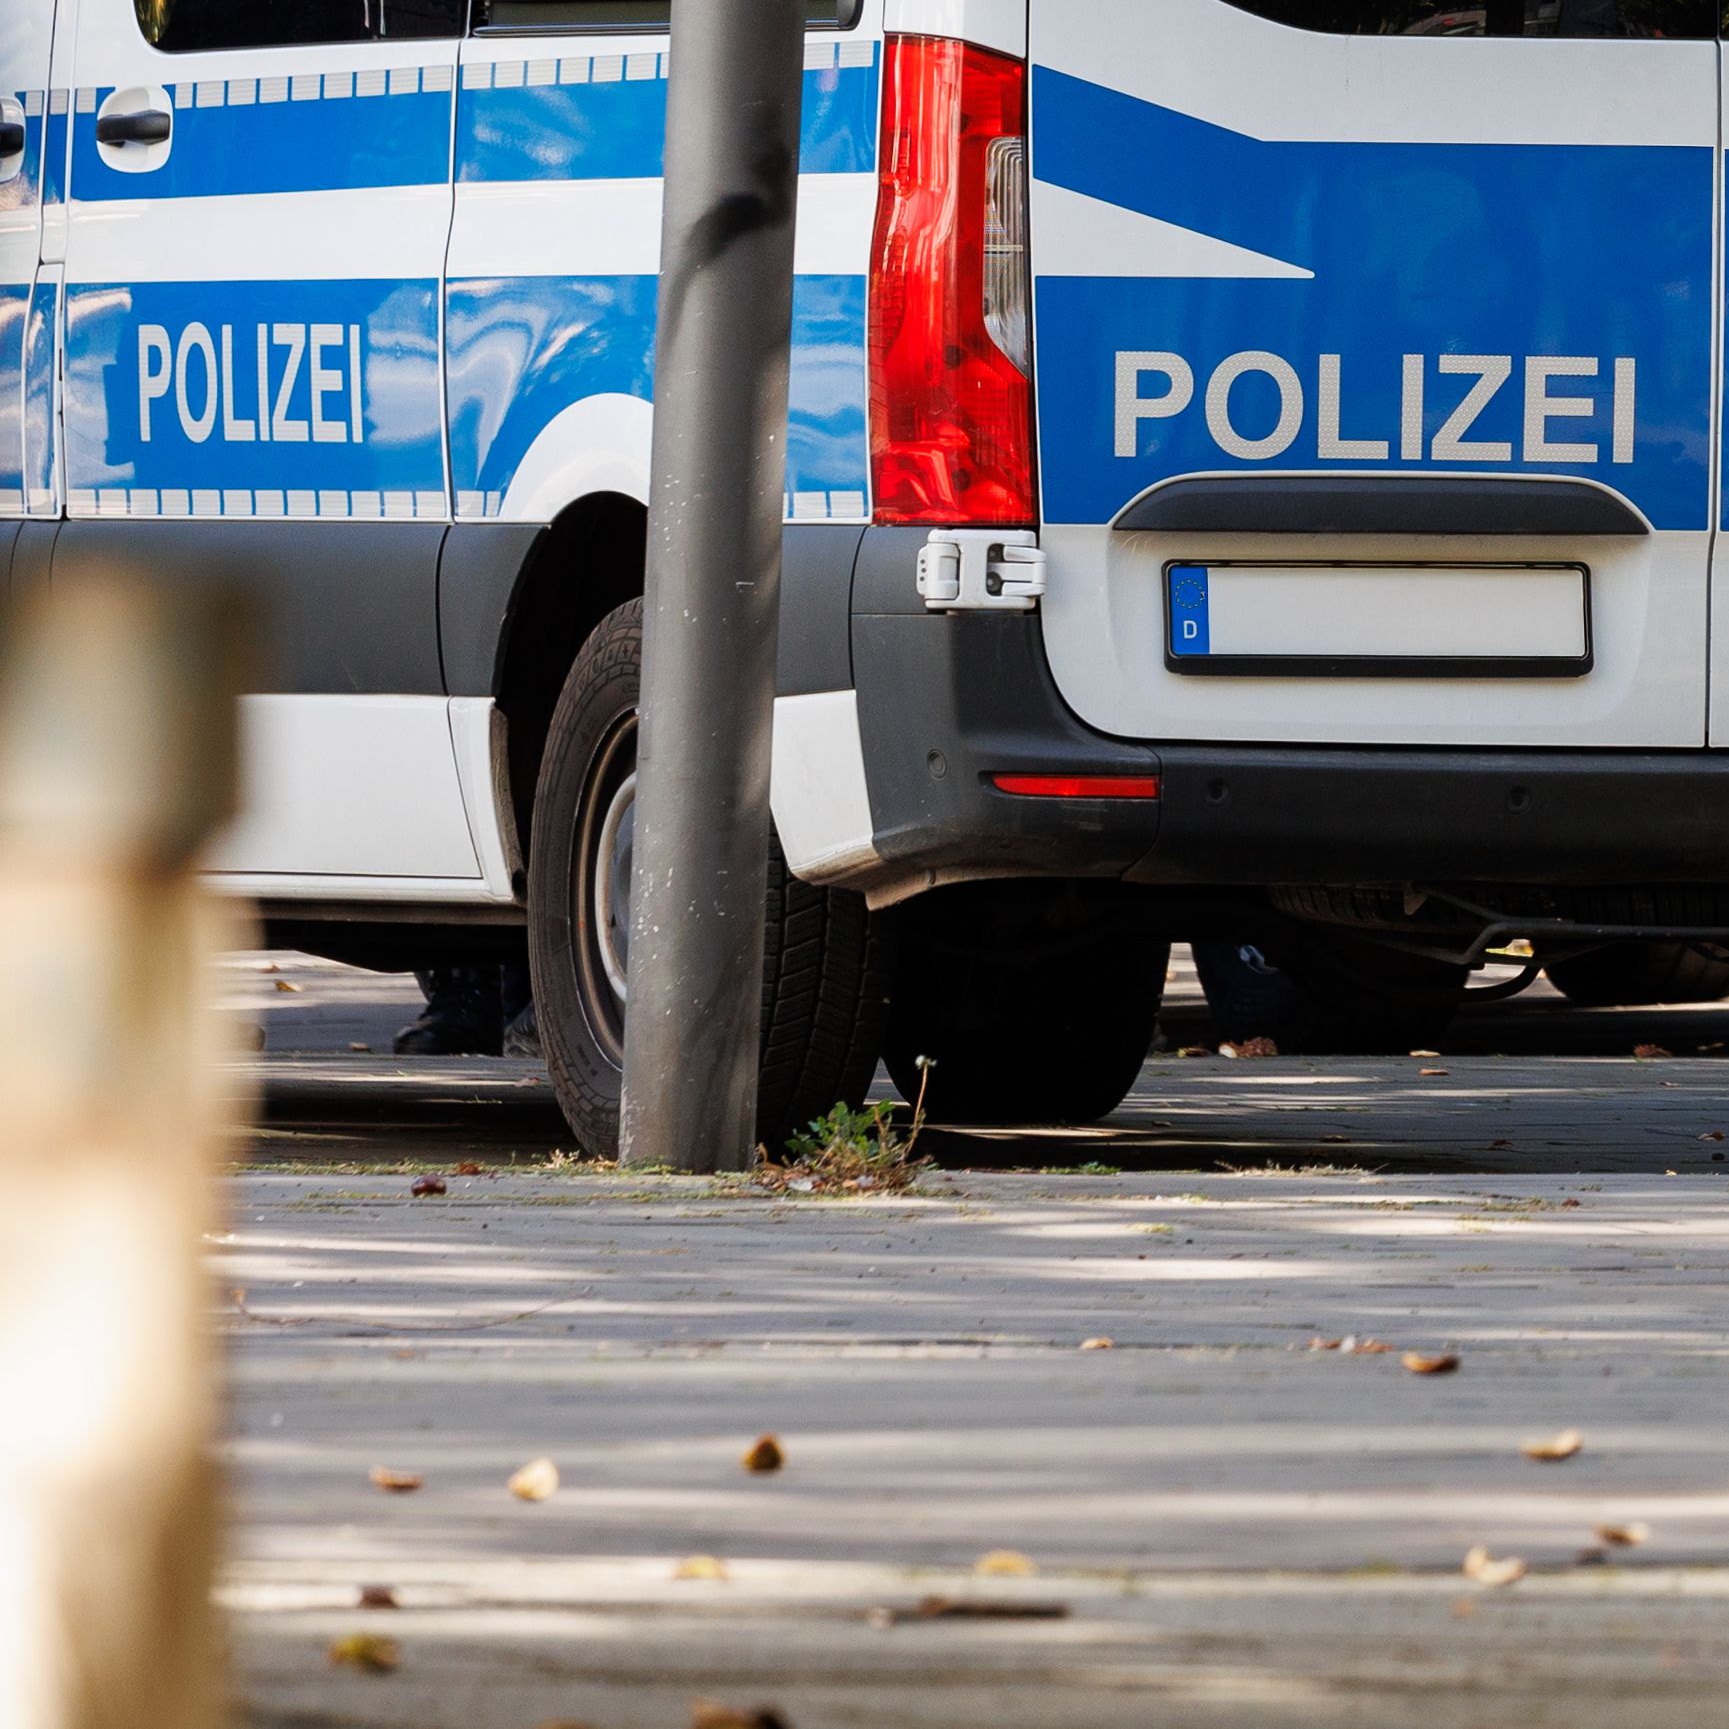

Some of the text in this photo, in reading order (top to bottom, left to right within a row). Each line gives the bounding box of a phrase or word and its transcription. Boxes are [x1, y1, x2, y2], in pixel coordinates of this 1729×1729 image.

[139, 321, 363, 443] POLIZEI
[1114, 351, 1636, 464] POLIZEI
[1183, 620, 1198, 639] D
